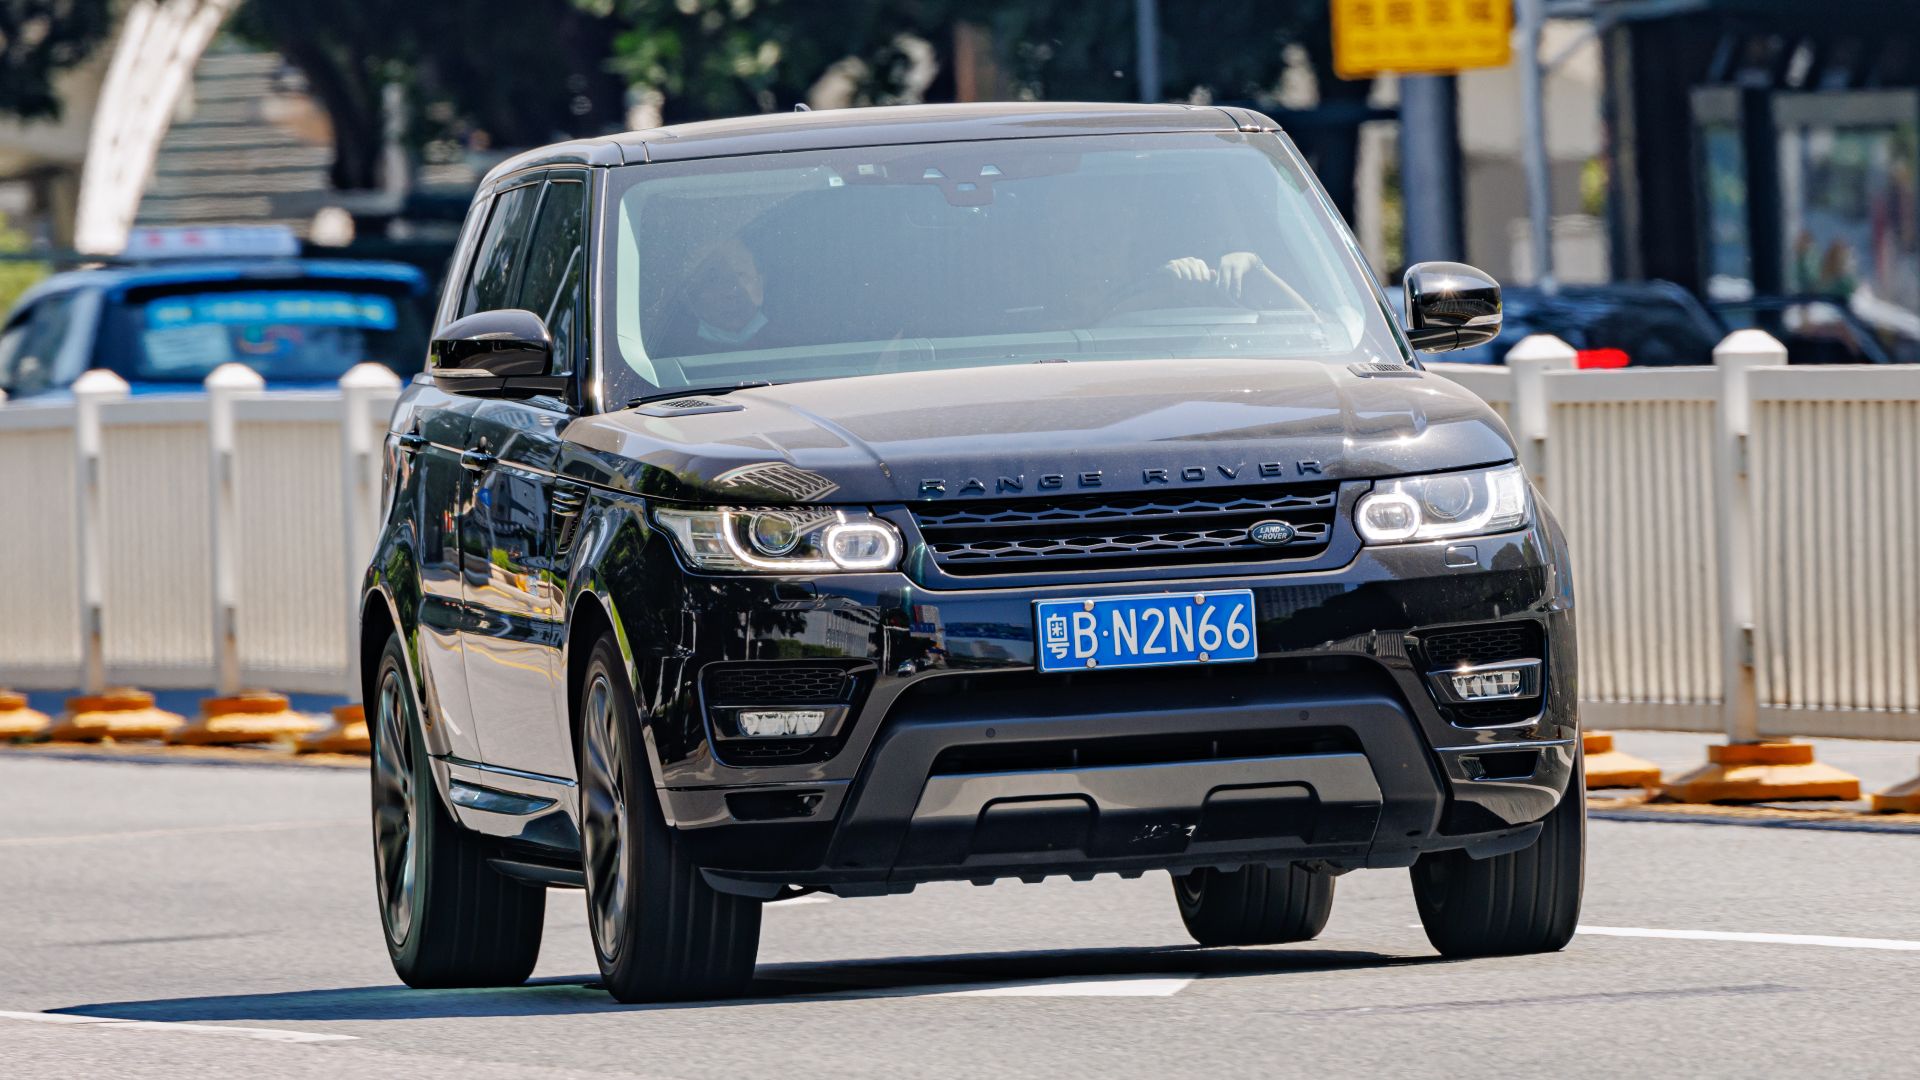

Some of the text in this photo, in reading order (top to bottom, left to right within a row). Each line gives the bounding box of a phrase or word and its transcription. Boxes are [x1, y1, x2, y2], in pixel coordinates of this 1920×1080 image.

[919, 460, 1322, 497] RANGE ROVER
[1262, 532, 1288, 540] ROVER
